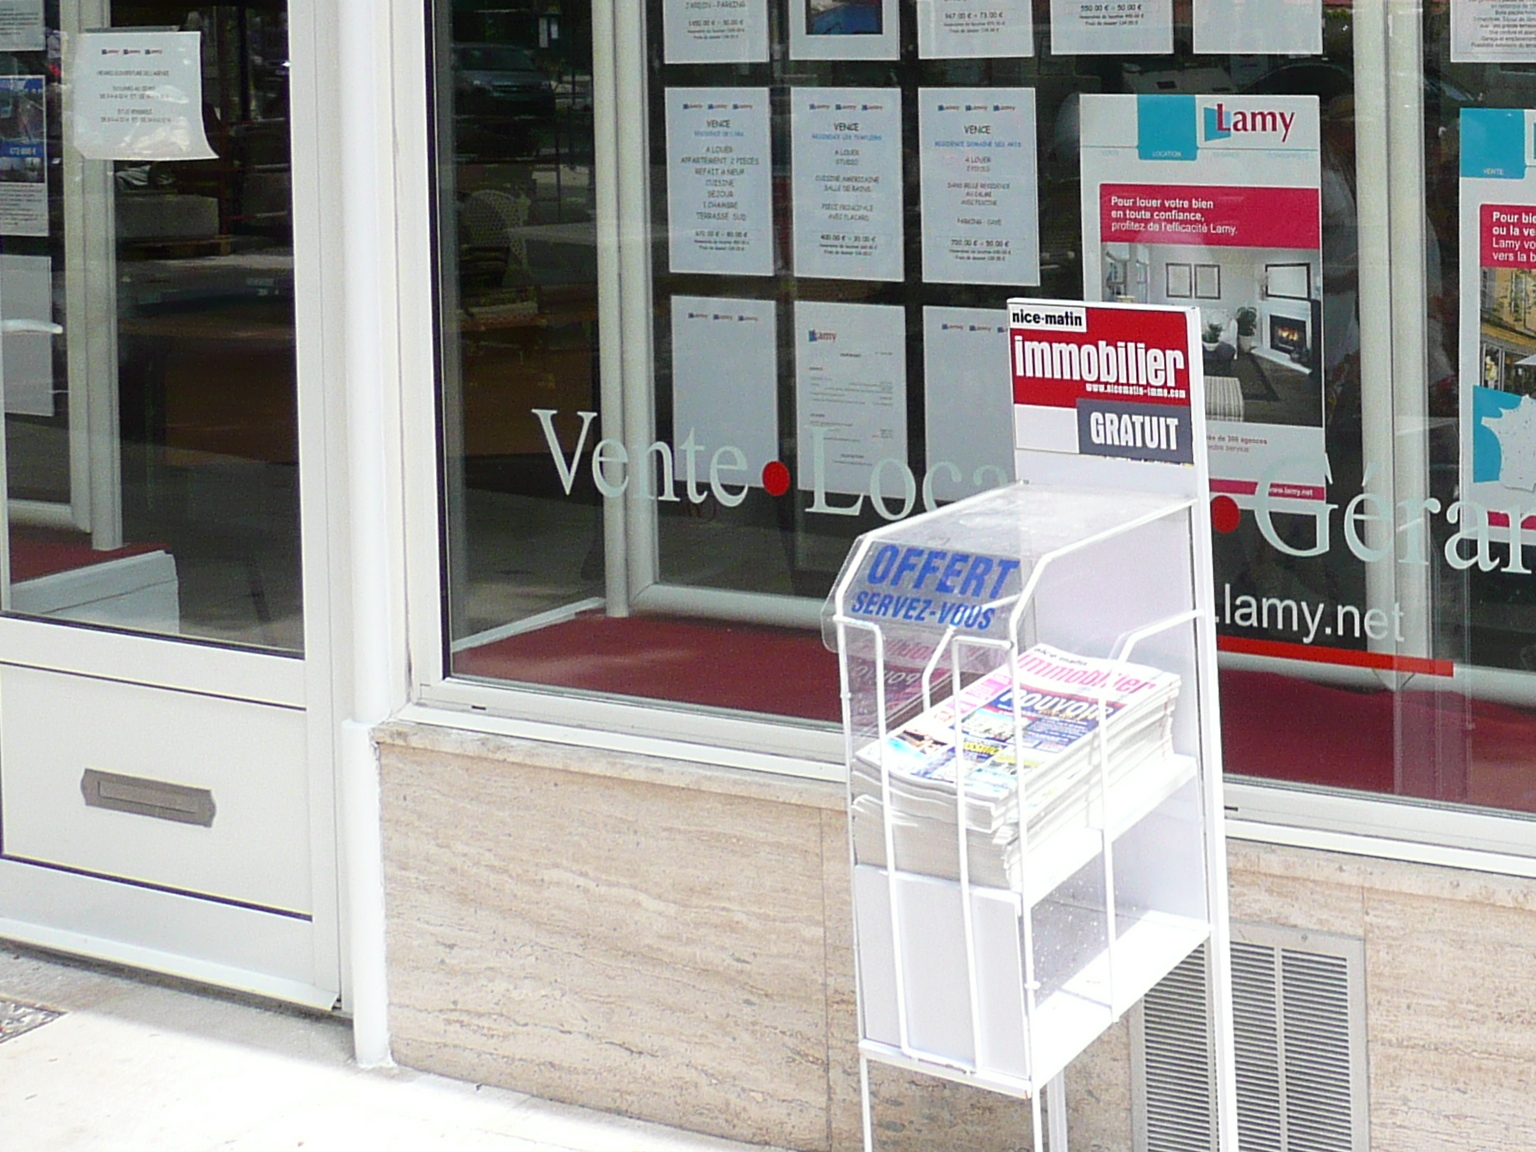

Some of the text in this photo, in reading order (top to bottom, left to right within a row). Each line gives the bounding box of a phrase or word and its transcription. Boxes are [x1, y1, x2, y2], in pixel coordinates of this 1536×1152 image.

[834, 122, 859, 132] VENCE
[1217, 103, 1295, 142] Lamy
[964, 125, 991, 135] VENCE
[1111, 196, 1214, 209] Pour louer votre bien
[1111, 210, 1205, 222] en toute confiance,
[1492, 212, 1519, 224] Pour
[1111, 221, 1146, 232] profitez
[1147, 222, 1159, 231] de
[1210, 224, 1238, 236] Lamy.
[1492, 227, 1507, 236] ou
[1510, 225, 1520, 236] la
[1492, 238, 1520, 251] Lamy
[1492, 252, 1514, 262] vers
[1518, 252, 1527, 262] la
[1012, 309, 1082, 326] nice-matin
[1015, 336, 1184, 387] immobilier
[1090, 412, 1178, 450] GRATUIT
[531, 409, 748, 508] Vente
[867, 544, 1021, 599] OFFERT
[851, 591, 995, 630] SERVEZ-VOUS
